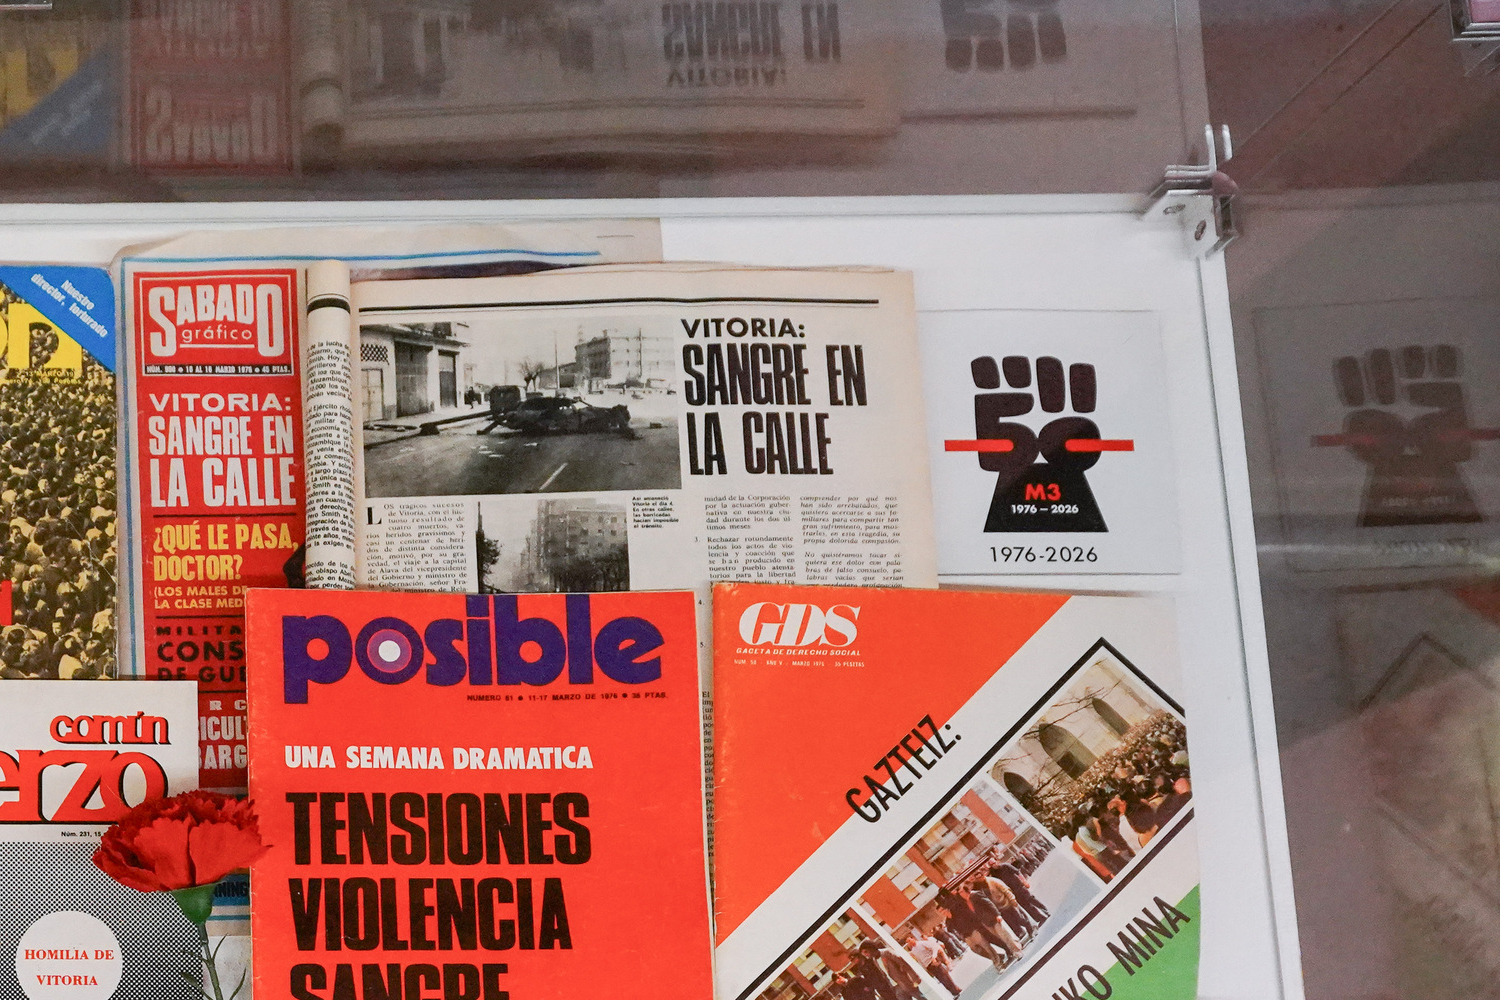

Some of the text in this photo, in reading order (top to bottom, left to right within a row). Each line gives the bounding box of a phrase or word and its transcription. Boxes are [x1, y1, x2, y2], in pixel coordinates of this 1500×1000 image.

[31, 273, 108, 337] director, torturado
[61, 280, 94, 310] Nuestro
[149, 283, 284, 357] SABADO
[182, 324, 252, 343] gráfico
[681, 318, 804, 338] VITORIA:
[682, 343, 867, 407] SANGRE EN
[150, 393, 291, 412] VITORIA:
[150, 415, 294, 455] SANGRE EN
[687, 411, 833, 476] LA CALLE
[150, 457, 297, 507] LA CALLE
[1025, 484, 1061, 501] M3
[1011, 504, 1079, 514] 1976 2026
[153, 520, 299, 553] ¿QUÉ LE PASA,
[153, 555, 243, 581] DOCTOR?
[989, 546, 1098, 563] 1976-2026
[739, 602, 861, 647] GDS
[282, 595, 665, 704] posible
[49, 711, 171, 745] común
[284, 746, 594, 770] UNA SEMANA DRAMATICA
[845, 714, 962, 824] GAZTEIZ:
[285, 792, 592, 866] TENSIONES
[288, 877, 573, 951] VIOLENCIA
[1106, 896, 1191, 976] MINA
[24, 948, 114, 962] HOMILIA DE
[37, 974, 98, 987] VITORIA
